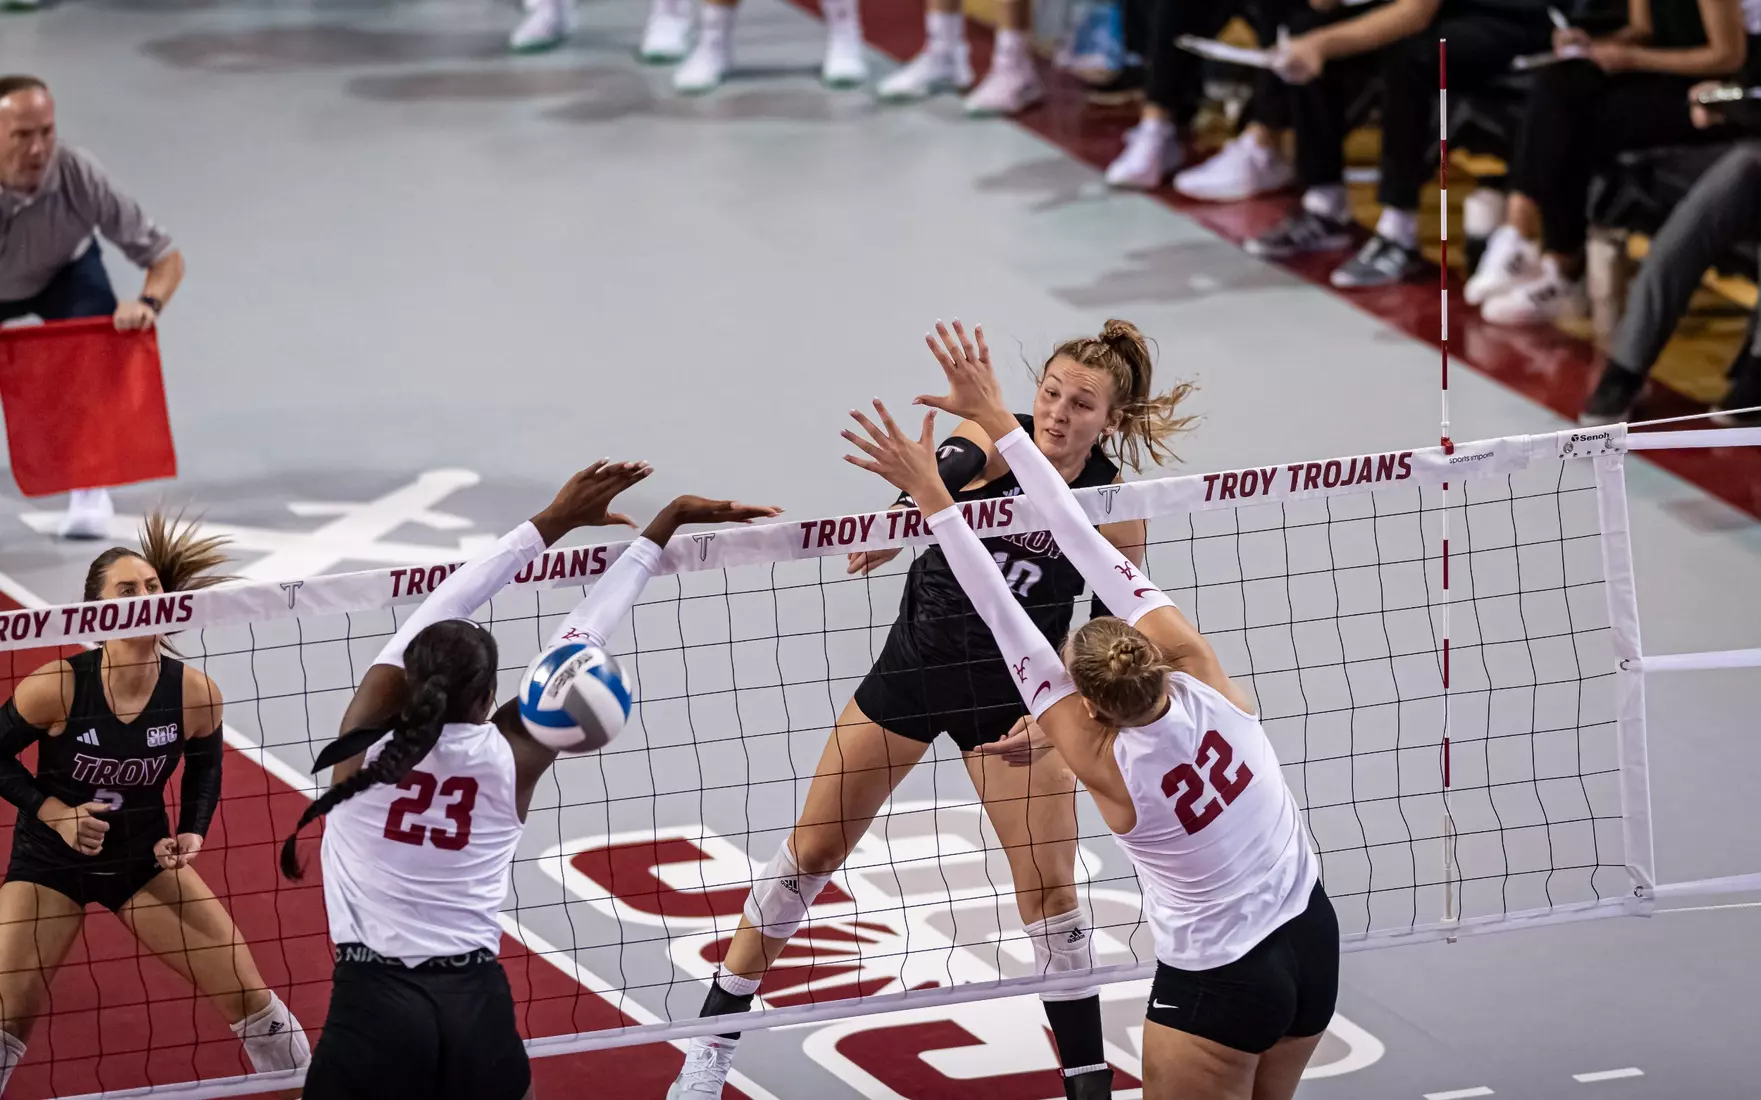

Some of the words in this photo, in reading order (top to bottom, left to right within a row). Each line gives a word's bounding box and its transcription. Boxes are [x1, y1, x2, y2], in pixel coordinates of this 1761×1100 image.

[1579, 432, 1610, 442] Senoh
[1203, 467, 1277, 502] TROY
[1288, 451, 1412, 492] TROJANS
[1449, 455, 1470, 465] sports
[800, 514, 876, 549] TROY
[887, 498, 1014, 540] TRANS
[506, 546, 607, 585] OJANS
[62, 594, 193, 635] TROJANS
[72, 753, 167, 786] TROY
[1161, 730, 1254, 836] 22
[383, 769, 479, 851] 23
[345, 947, 404, 966] NIK
